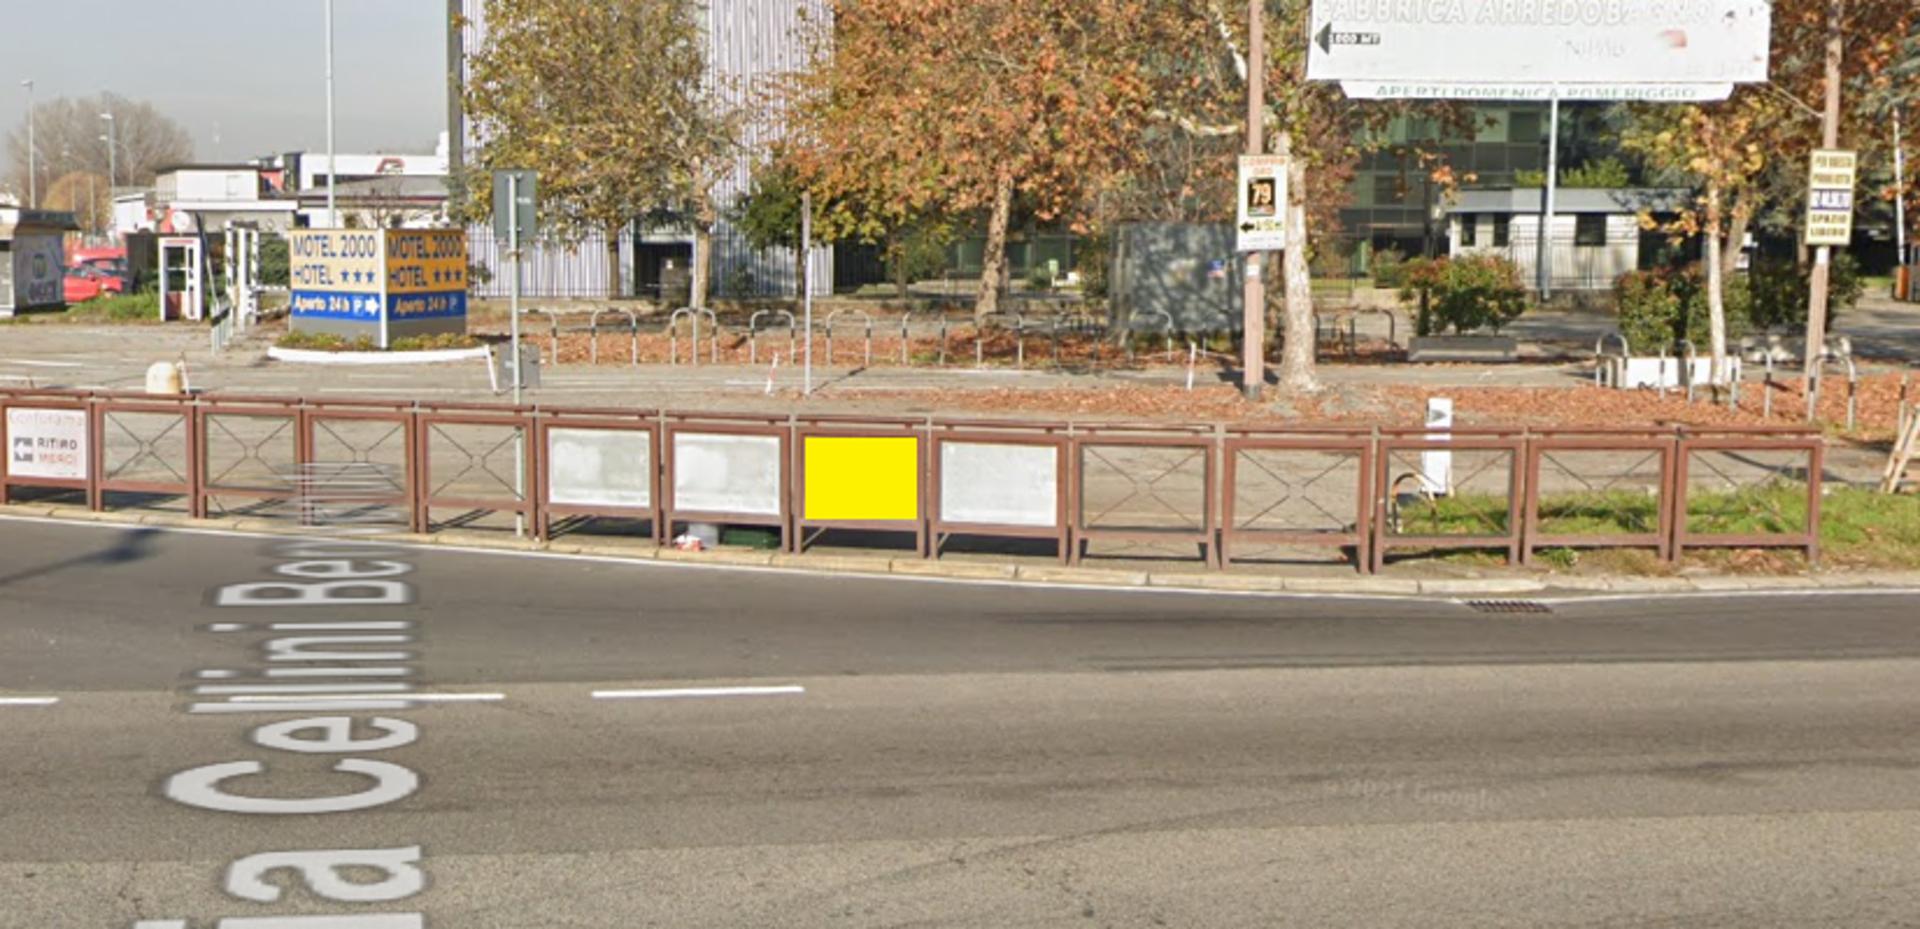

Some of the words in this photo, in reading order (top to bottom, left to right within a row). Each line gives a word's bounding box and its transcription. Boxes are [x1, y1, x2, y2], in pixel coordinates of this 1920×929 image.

[1317, 0, 1467, 24] FABBRICA
[1375, 84, 1446, 97] APERTI
[1453, 84, 1559, 98] DOMENICA
[1567, 86, 1697, 99] POMERIGGIO
[1251, 182, 1272, 204] 79
[293, 234, 337, 258] MOTEL
[340, 234, 376, 258] 2000
[387, 236, 430, 259] MOTEL
[432, 235, 462, 259] 2000
[294, 264, 335, 285] HOTEL
[389, 265, 428, 287] HOTEL
[294, 294, 326, 313] Aperto
[395, 297, 425, 316] Aperto
[37, 437, 78, 450] RITIRO
